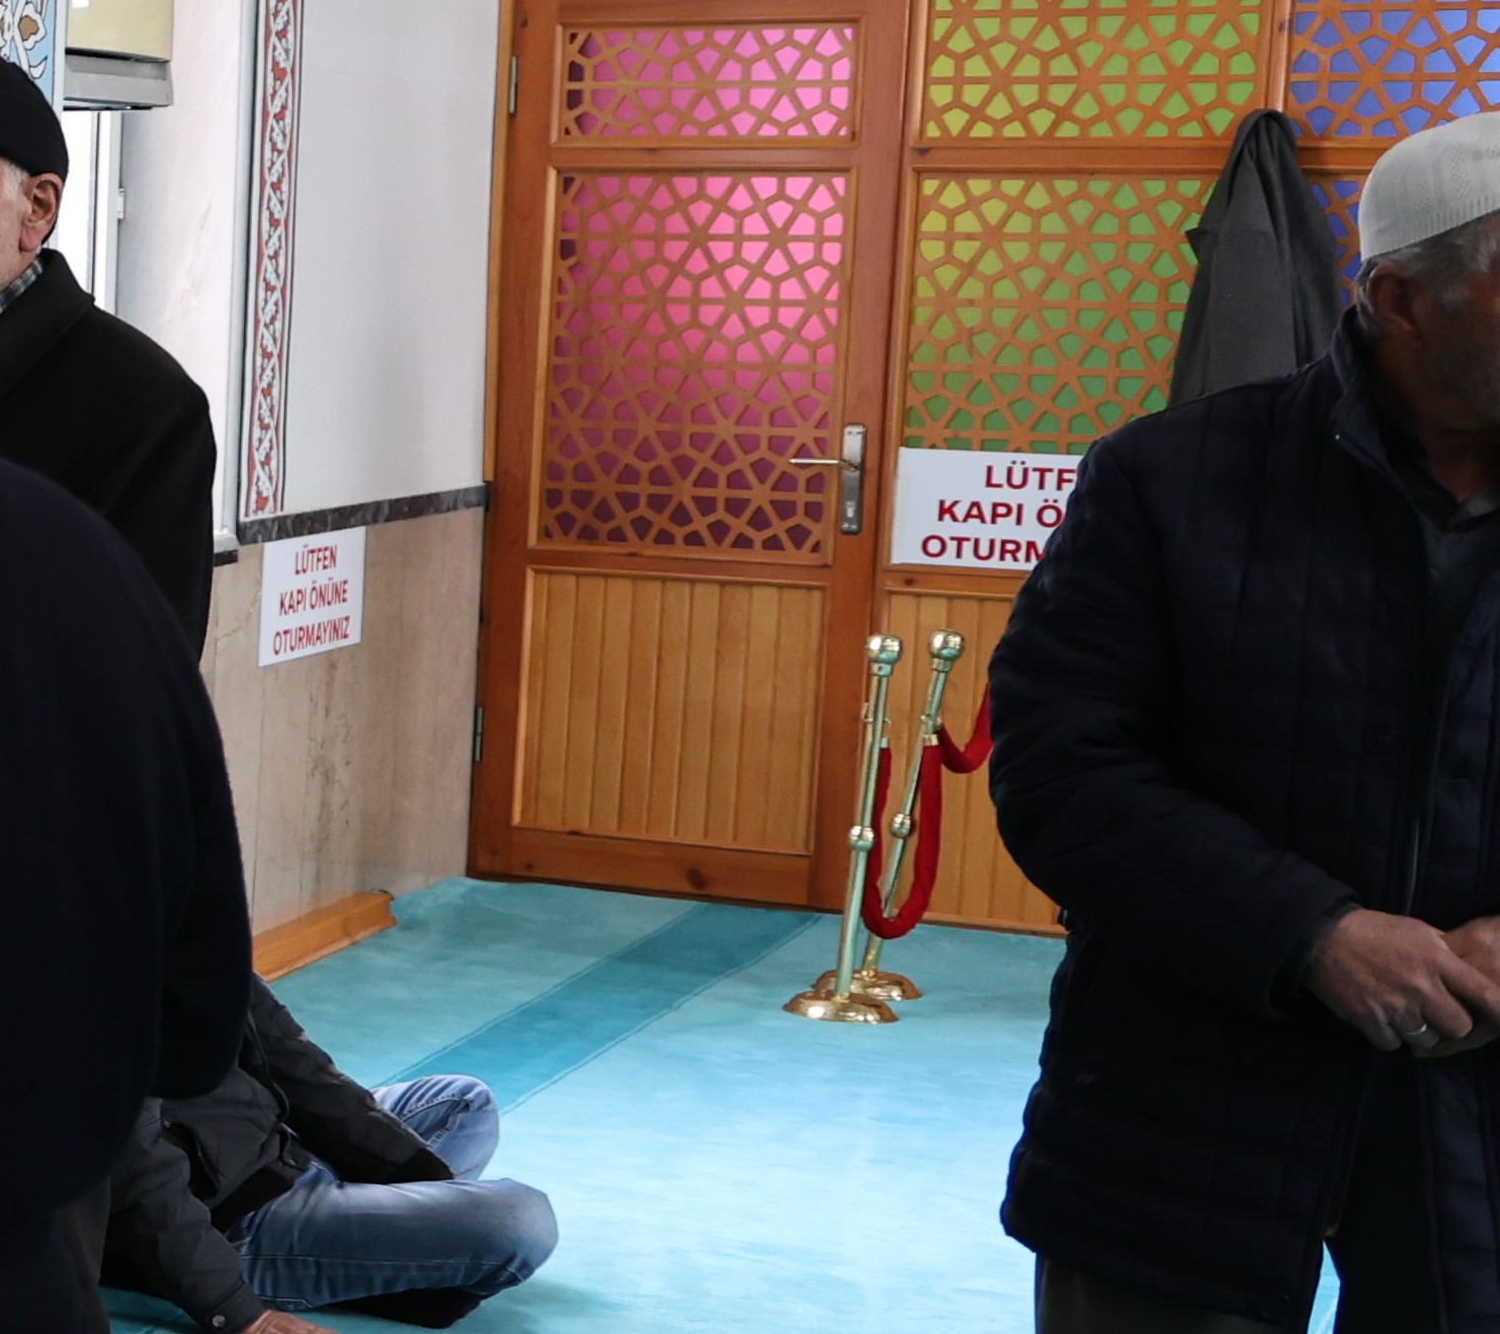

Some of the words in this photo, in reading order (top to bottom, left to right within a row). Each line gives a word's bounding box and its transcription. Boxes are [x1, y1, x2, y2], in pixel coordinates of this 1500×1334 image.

[984, 460, 1077, 491] LÜTF
[937, 499, 1024, 526] KAPI
[295, 544, 337, 575] LÜTFEN
[280, 588, 306, 615] KAPI
[310, 578, 348, 609] ÖNÜNE
[274, 616, 350, 655] OTURMAYINIZ
